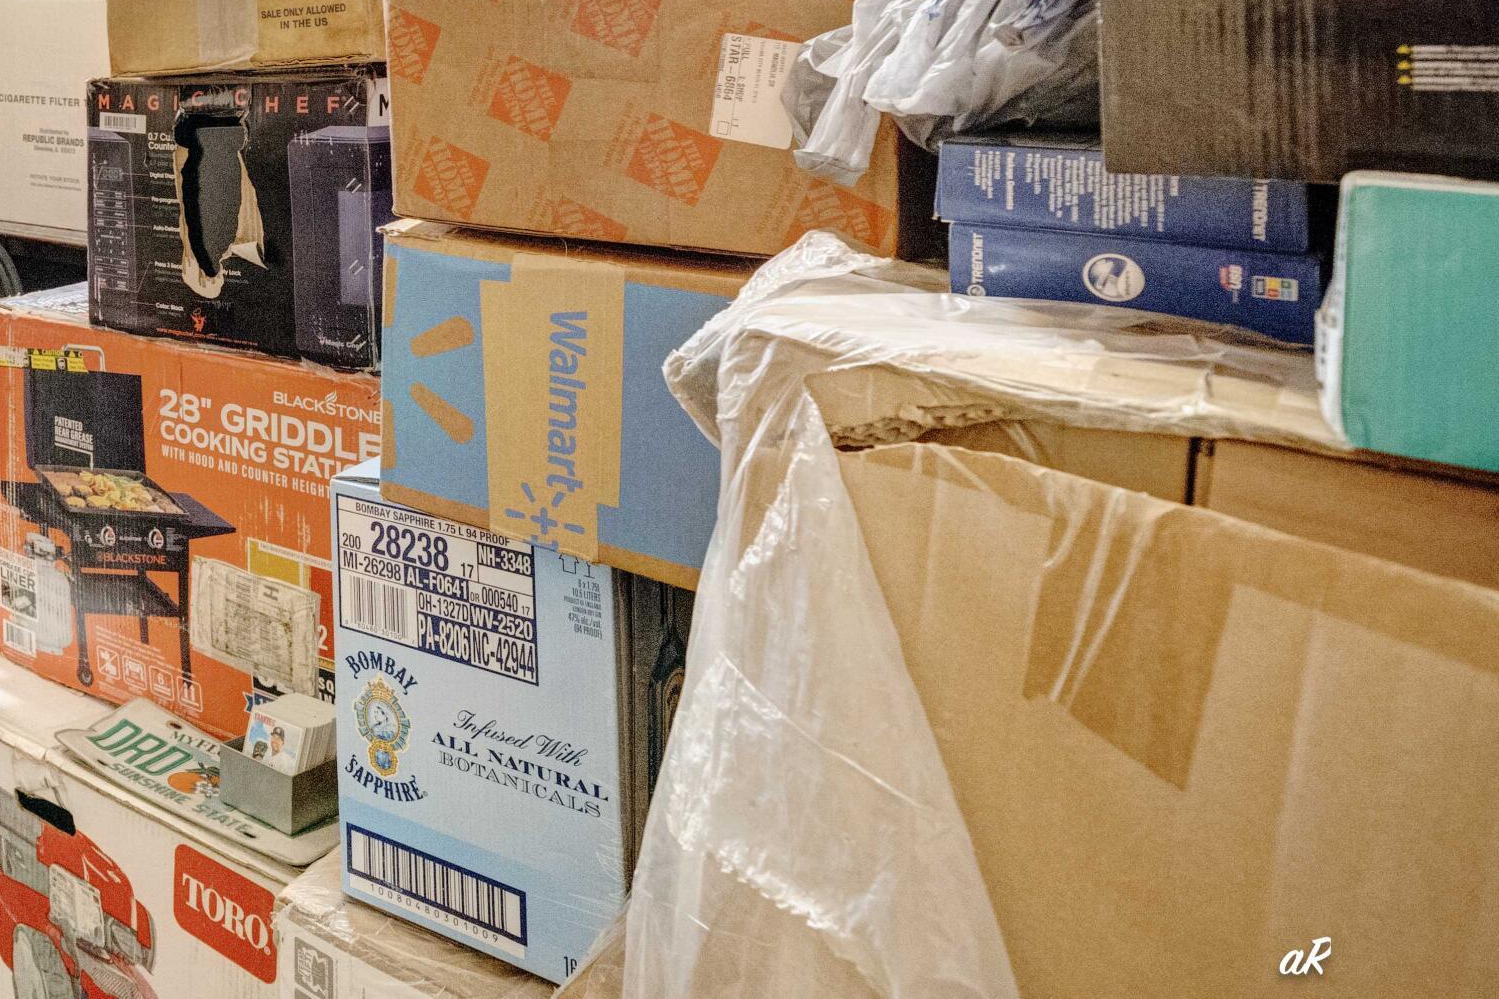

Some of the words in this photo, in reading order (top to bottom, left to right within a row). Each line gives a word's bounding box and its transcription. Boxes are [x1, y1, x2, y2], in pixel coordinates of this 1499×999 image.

[260, 9, 282, 19] SALE
[283, 7, 304, 17] ONLY
[305, 3, 347, 15] ALLOWED
[280, 20, 290, 30] IN
[292, 19, 311, 29] THE
[314, 17, 329, 27] US
[728, 35, 742, 65] STAR
[49, 97, 80, 107] FILTER
[98, 90, 205, 111] MAGIC
[234, 88, 344, 114] CHEF
[22, 134, 55, 145] REPUBLIC
[56, 136, 85, 147] BRANDS
[148, 133, 158, 141] 0.7
[273, 391, 381, 424] BLACKSTONE
[547, 311, 588, 494] Walmart
[54, 415, 83, 432] PATENTED
[54, 425, 70, 439] REAR
[70, 429, 94, 445] GREASE
[159, 389, 212, 424] 28"
[220, 403, 382, 462] GRIDDLE
[160, 421, 268, 464] COOKING
[273, 447, 355, 480] STATI
[161, 444, 185, 462] WITH
[188, 451, 215, 469] HOOD
[218, 460, 238, 476] AND
[241, 464, 288, 489] COUNTER
[291, 478, 330, 500] HEIGHT
[355, 502, 391, 519] BOMBAY
[392, 511, 435, 530] SAPPHIRE
[437, 521, 456, 534] 1.75
[458, 526, 464, 536] L
[466, 529, 477, 539] 94
[479, 532, 511, 547] PROOF
[104, 553, 166, 565] BLACKSTONE
[342, 532, 361, 550] 200
[370, 521, 449, 572] 28238
[460, 562, 474, 579] 17
[342, 550, 401, 582] MI-26298
[478, 543, 532, 576] NH-3348
[0, 567, 36, 592] LINER
[406, 568, 468, 600] AL-F0641
[418, 591, 470, 623] OH-1327D
[470, 591, 480, 602] OR
[481, 586, 518, 613] 000540
[521, 605, 530, 615] 17
[418, 613, 471, 661] PA-8206
[471, 604, 533, 641] WV-2520
[471, 627, 535, 680] NC-42944
[345, 651, 418, 696] BOMBAY
[453, 709, 535, 750] Infused
[535, 734, 589, 767] With
[345, 754, 424, 802] SAPPHIRE
[430, 731, 478, 758] ALL
[487, 748, 609, 802] NATURAL
[105, 762, 192, 805] SUNSHINE
[191, 803, 250, 834] STATE
[438, 750, 601, 818] BOTANICALS
[182, 872, 269, 950] TORO
